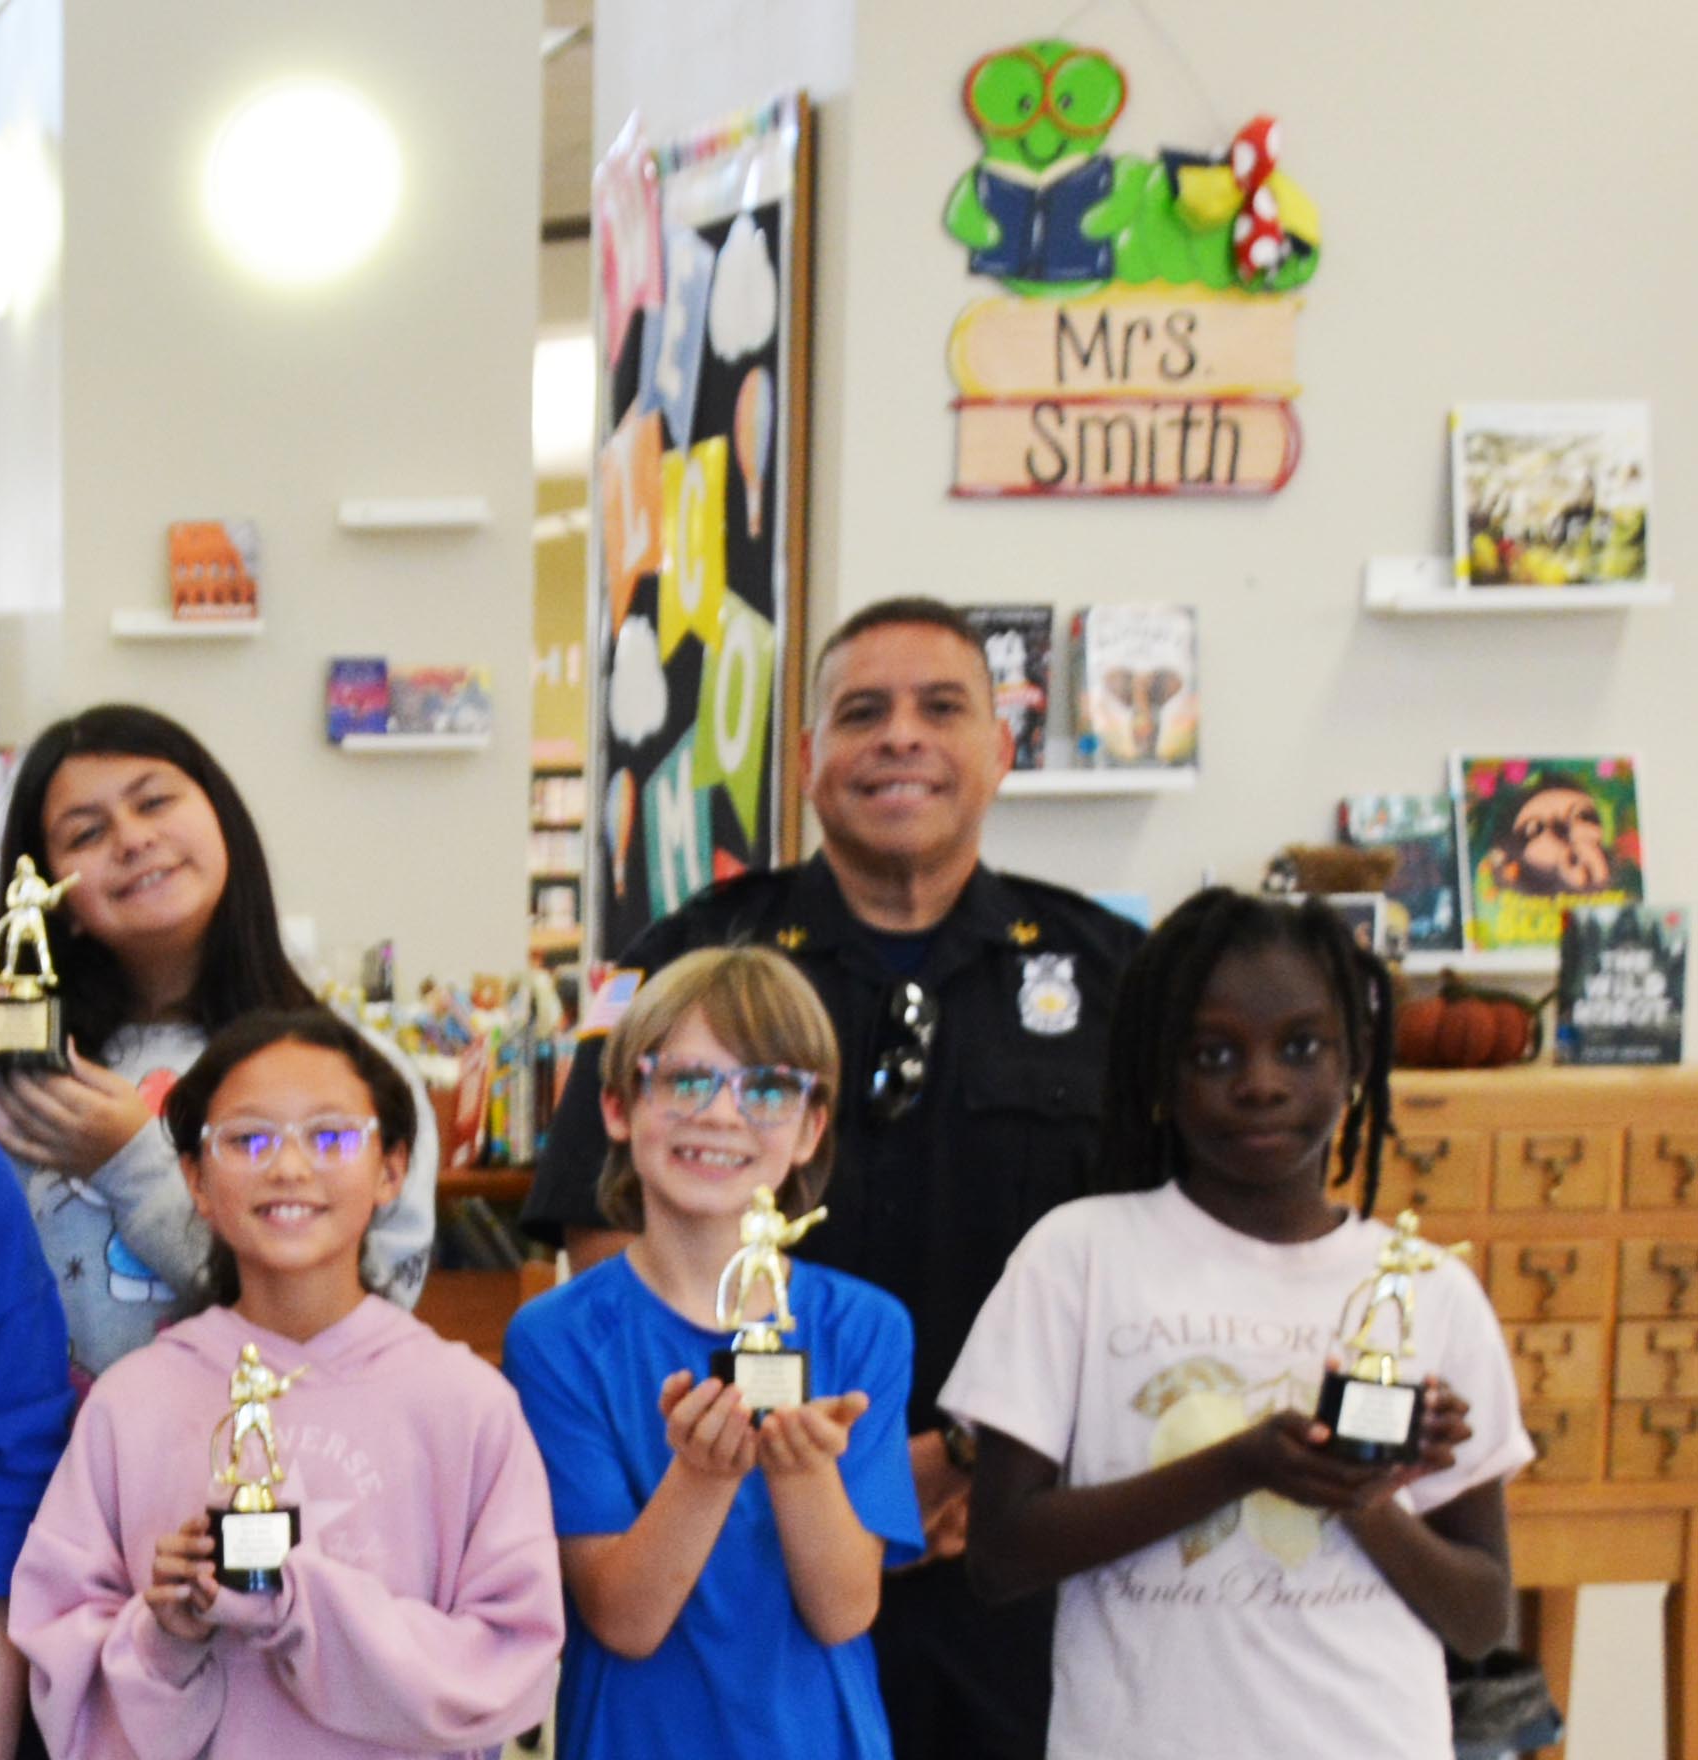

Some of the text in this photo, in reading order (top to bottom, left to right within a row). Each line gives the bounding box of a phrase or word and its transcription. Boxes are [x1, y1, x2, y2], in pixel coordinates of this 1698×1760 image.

[1053, 310, 1216, 385] Mrs.
[1026, 401, 1243, 487] Smith
[1106, 1312, 1320, 1360] CALIFOR
